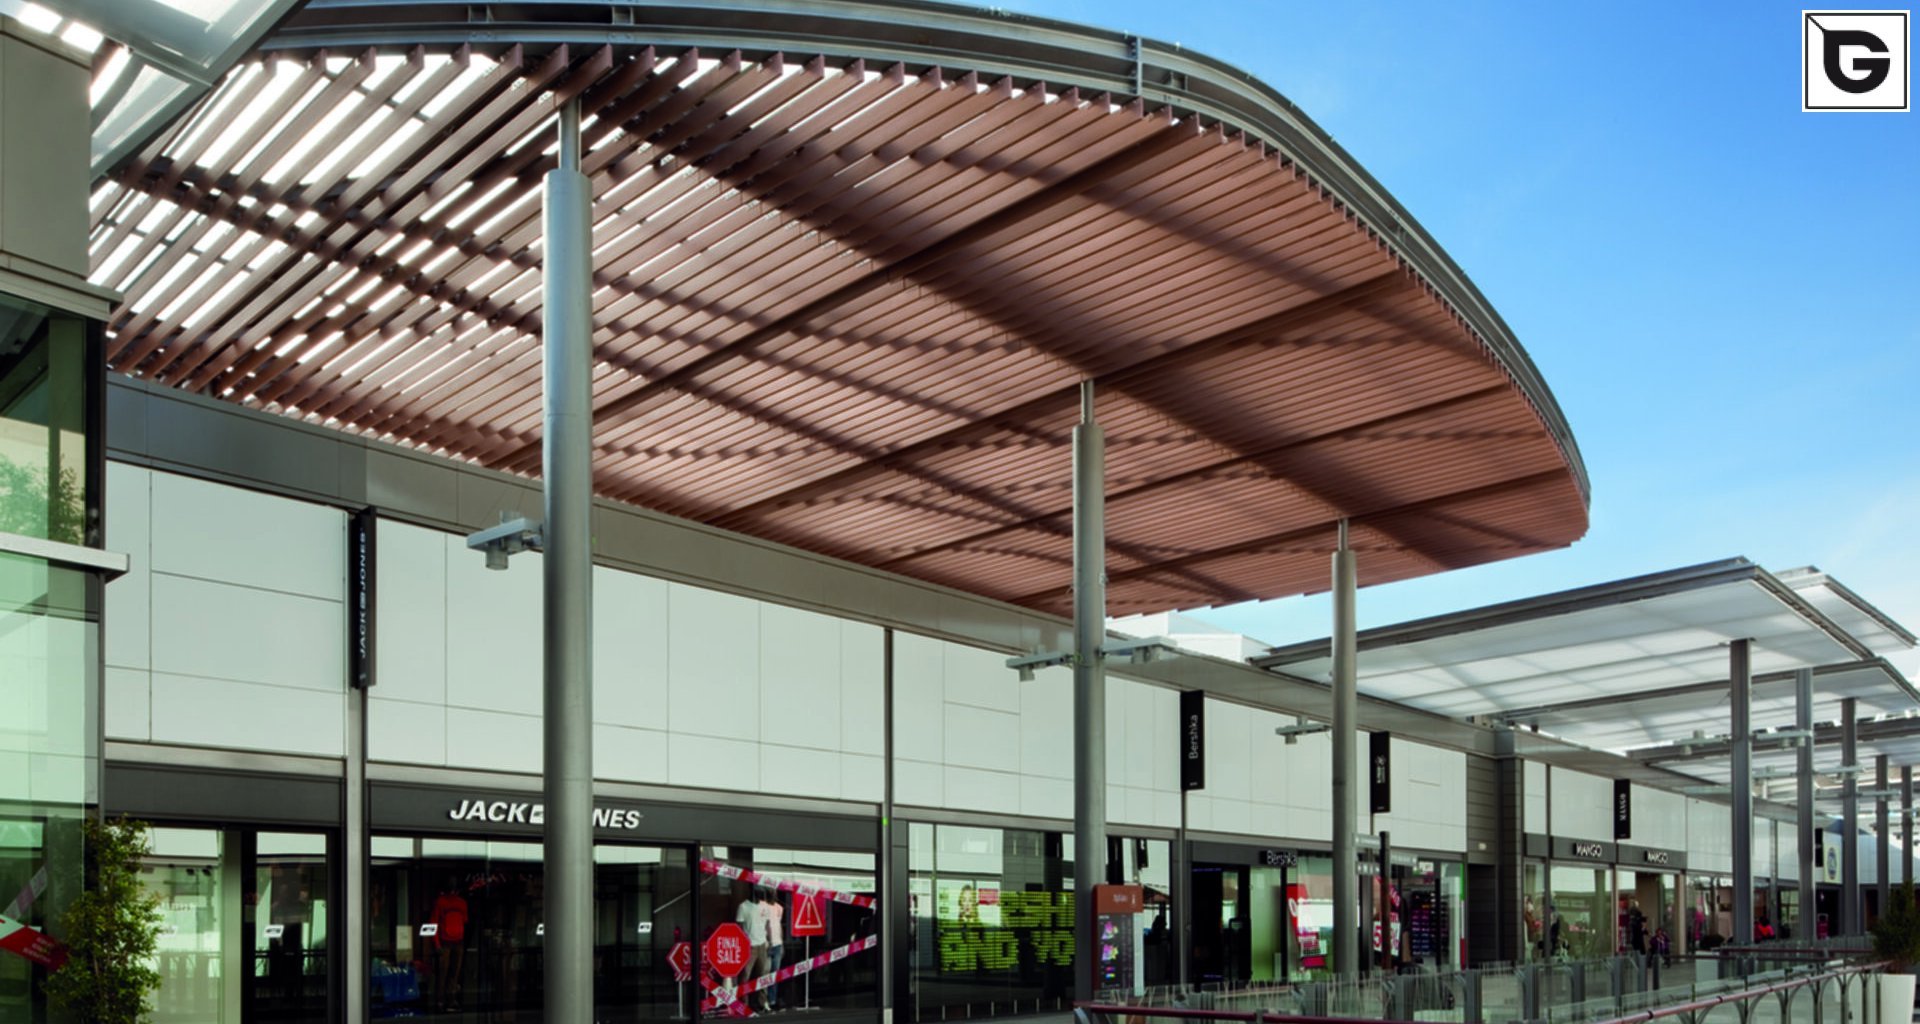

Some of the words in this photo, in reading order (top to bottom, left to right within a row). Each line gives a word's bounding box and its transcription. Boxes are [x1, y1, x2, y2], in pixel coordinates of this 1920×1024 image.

[1188, 714, 1199, 759] Bershka
[450, 800, 526, 824] JACK
[1619, 793, 1627, 821] MANGO
[1266, 850, 1297, 866] Bershka
[1575, 843, 1603, 858] MANGO
[1647, 851, 1669, 864] MANGO
[716, 936, 741, 950] FINAL
[716, 949, 742, 965] SALE
